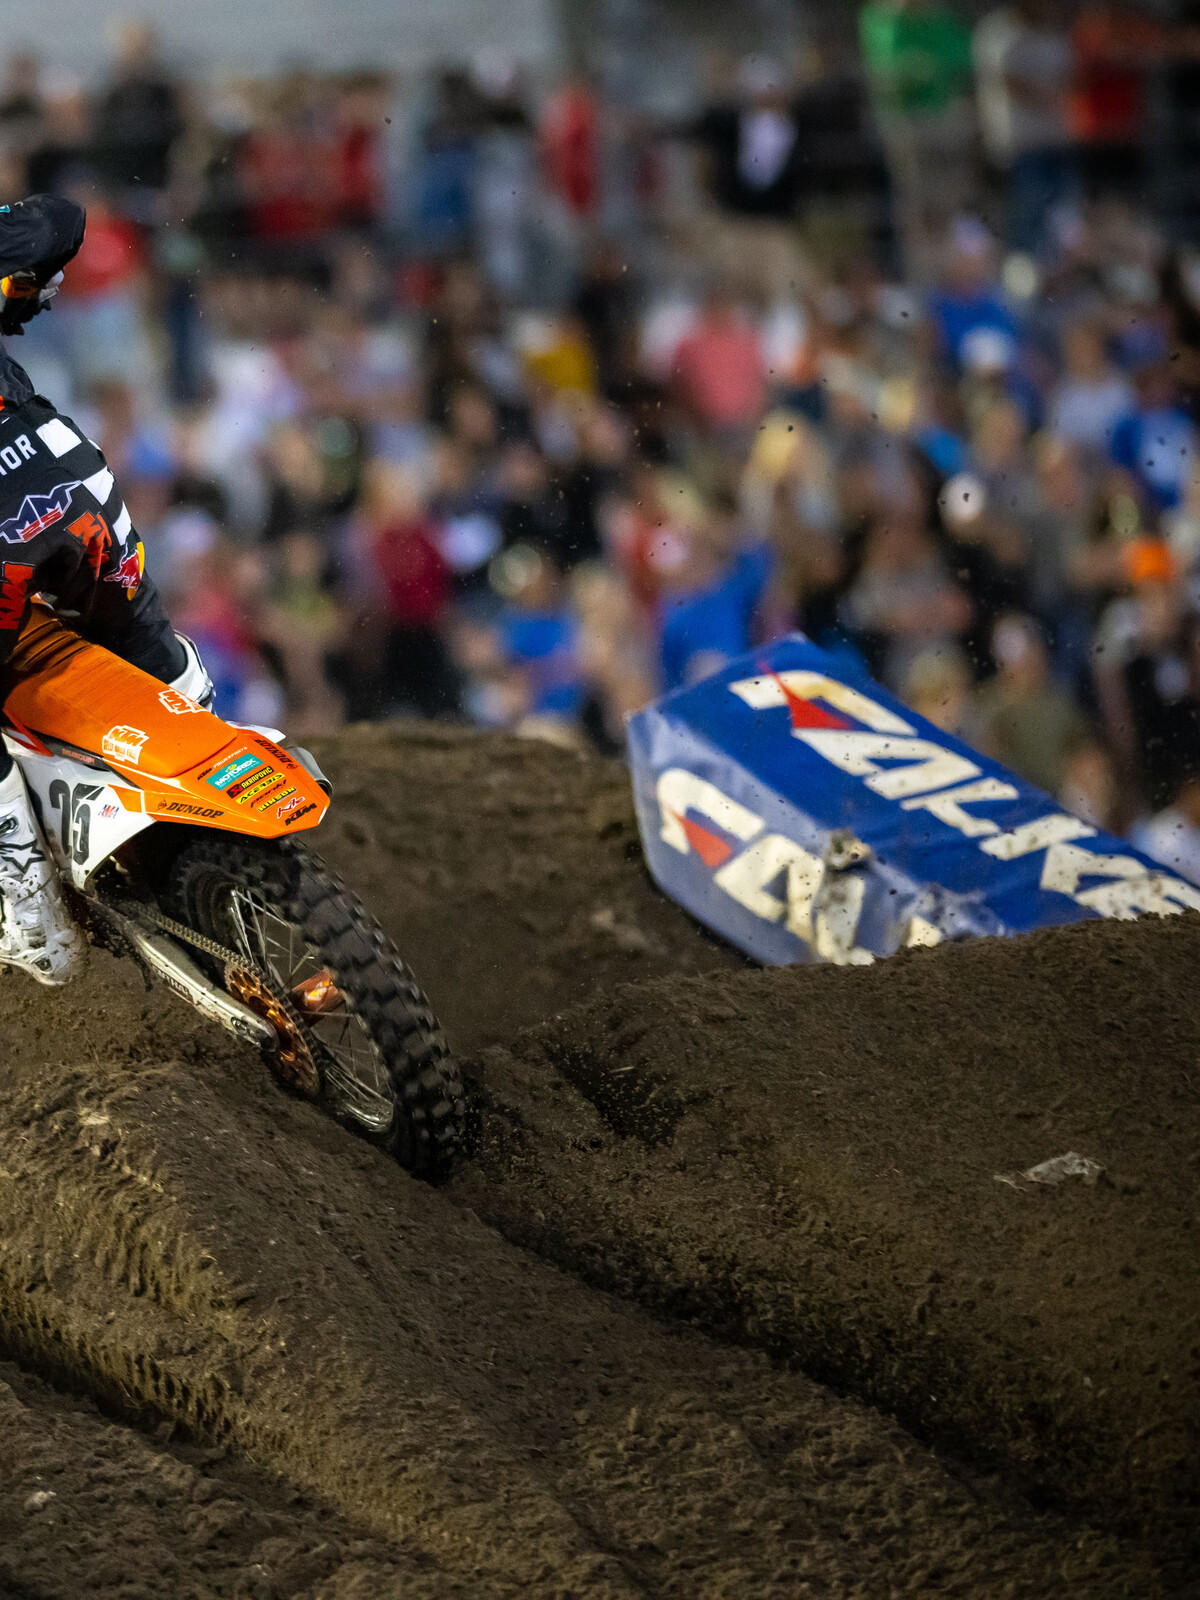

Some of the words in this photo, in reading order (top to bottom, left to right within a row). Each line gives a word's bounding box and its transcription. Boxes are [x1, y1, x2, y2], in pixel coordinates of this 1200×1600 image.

[161, 690, 193, 713] KTM
[107, 726, 147, 747] KTM
[214, 758, 257, 787] MOTOREX
[166, 802, 225, 818] DUNLOP
[285, 803, 317, 826] KTM
[49, 779, 105, 866] 25
